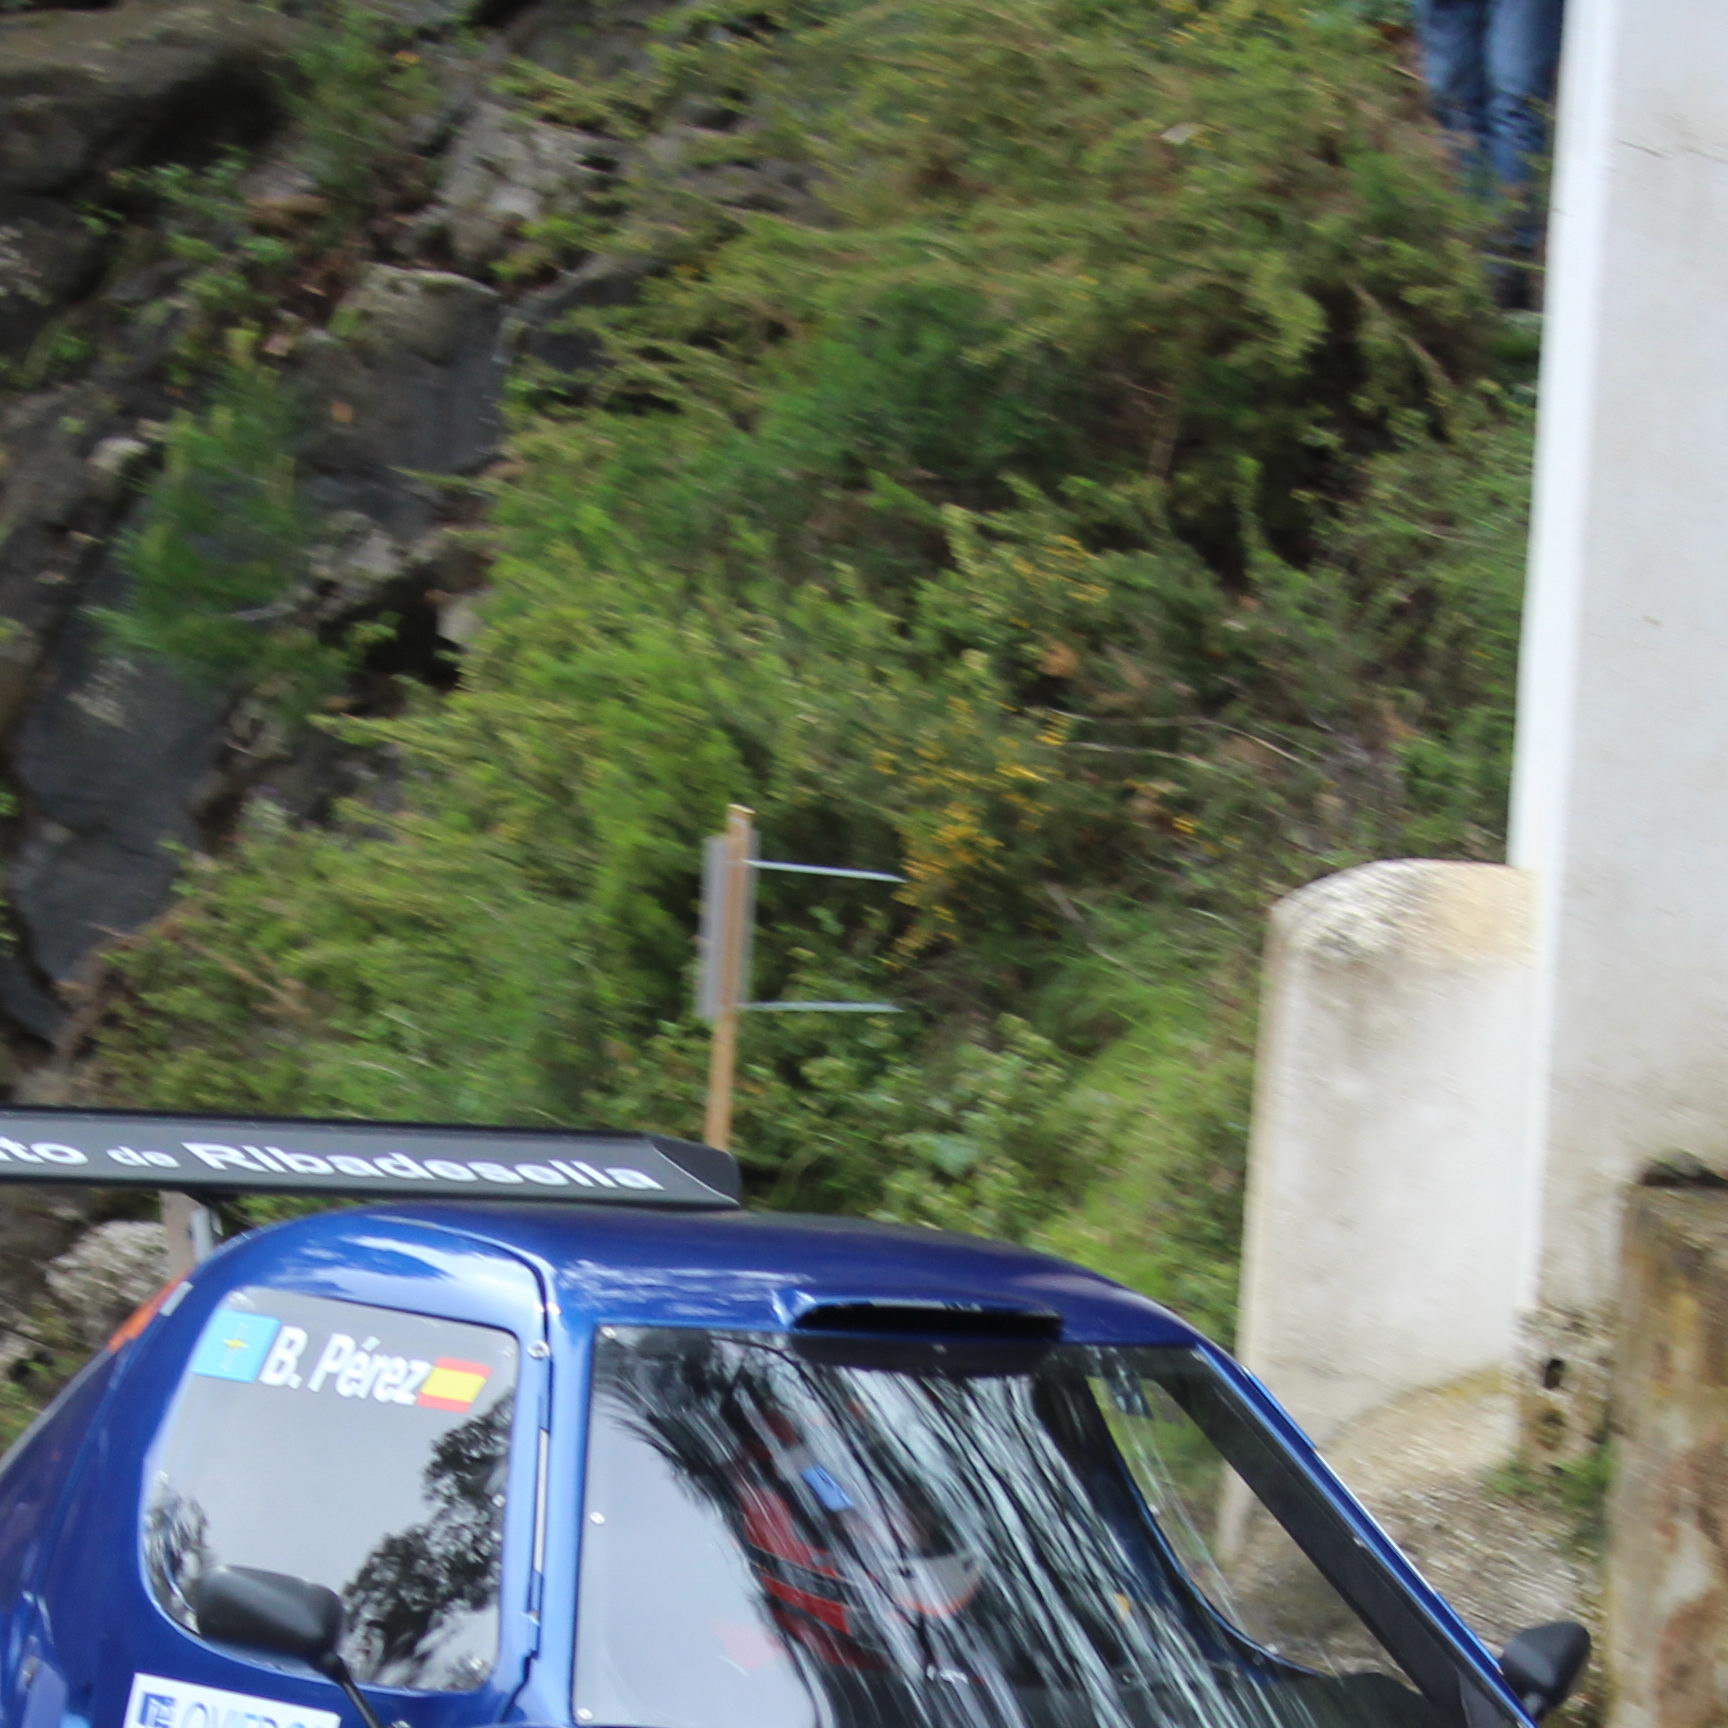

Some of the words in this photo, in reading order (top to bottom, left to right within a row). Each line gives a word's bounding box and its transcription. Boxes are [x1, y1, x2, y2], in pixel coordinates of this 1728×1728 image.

[182, 1140, 665, 1191] Ribadesella
[258, 1326, 308, 1390] B.
[307, 1333, 433, 1406] Pérez
